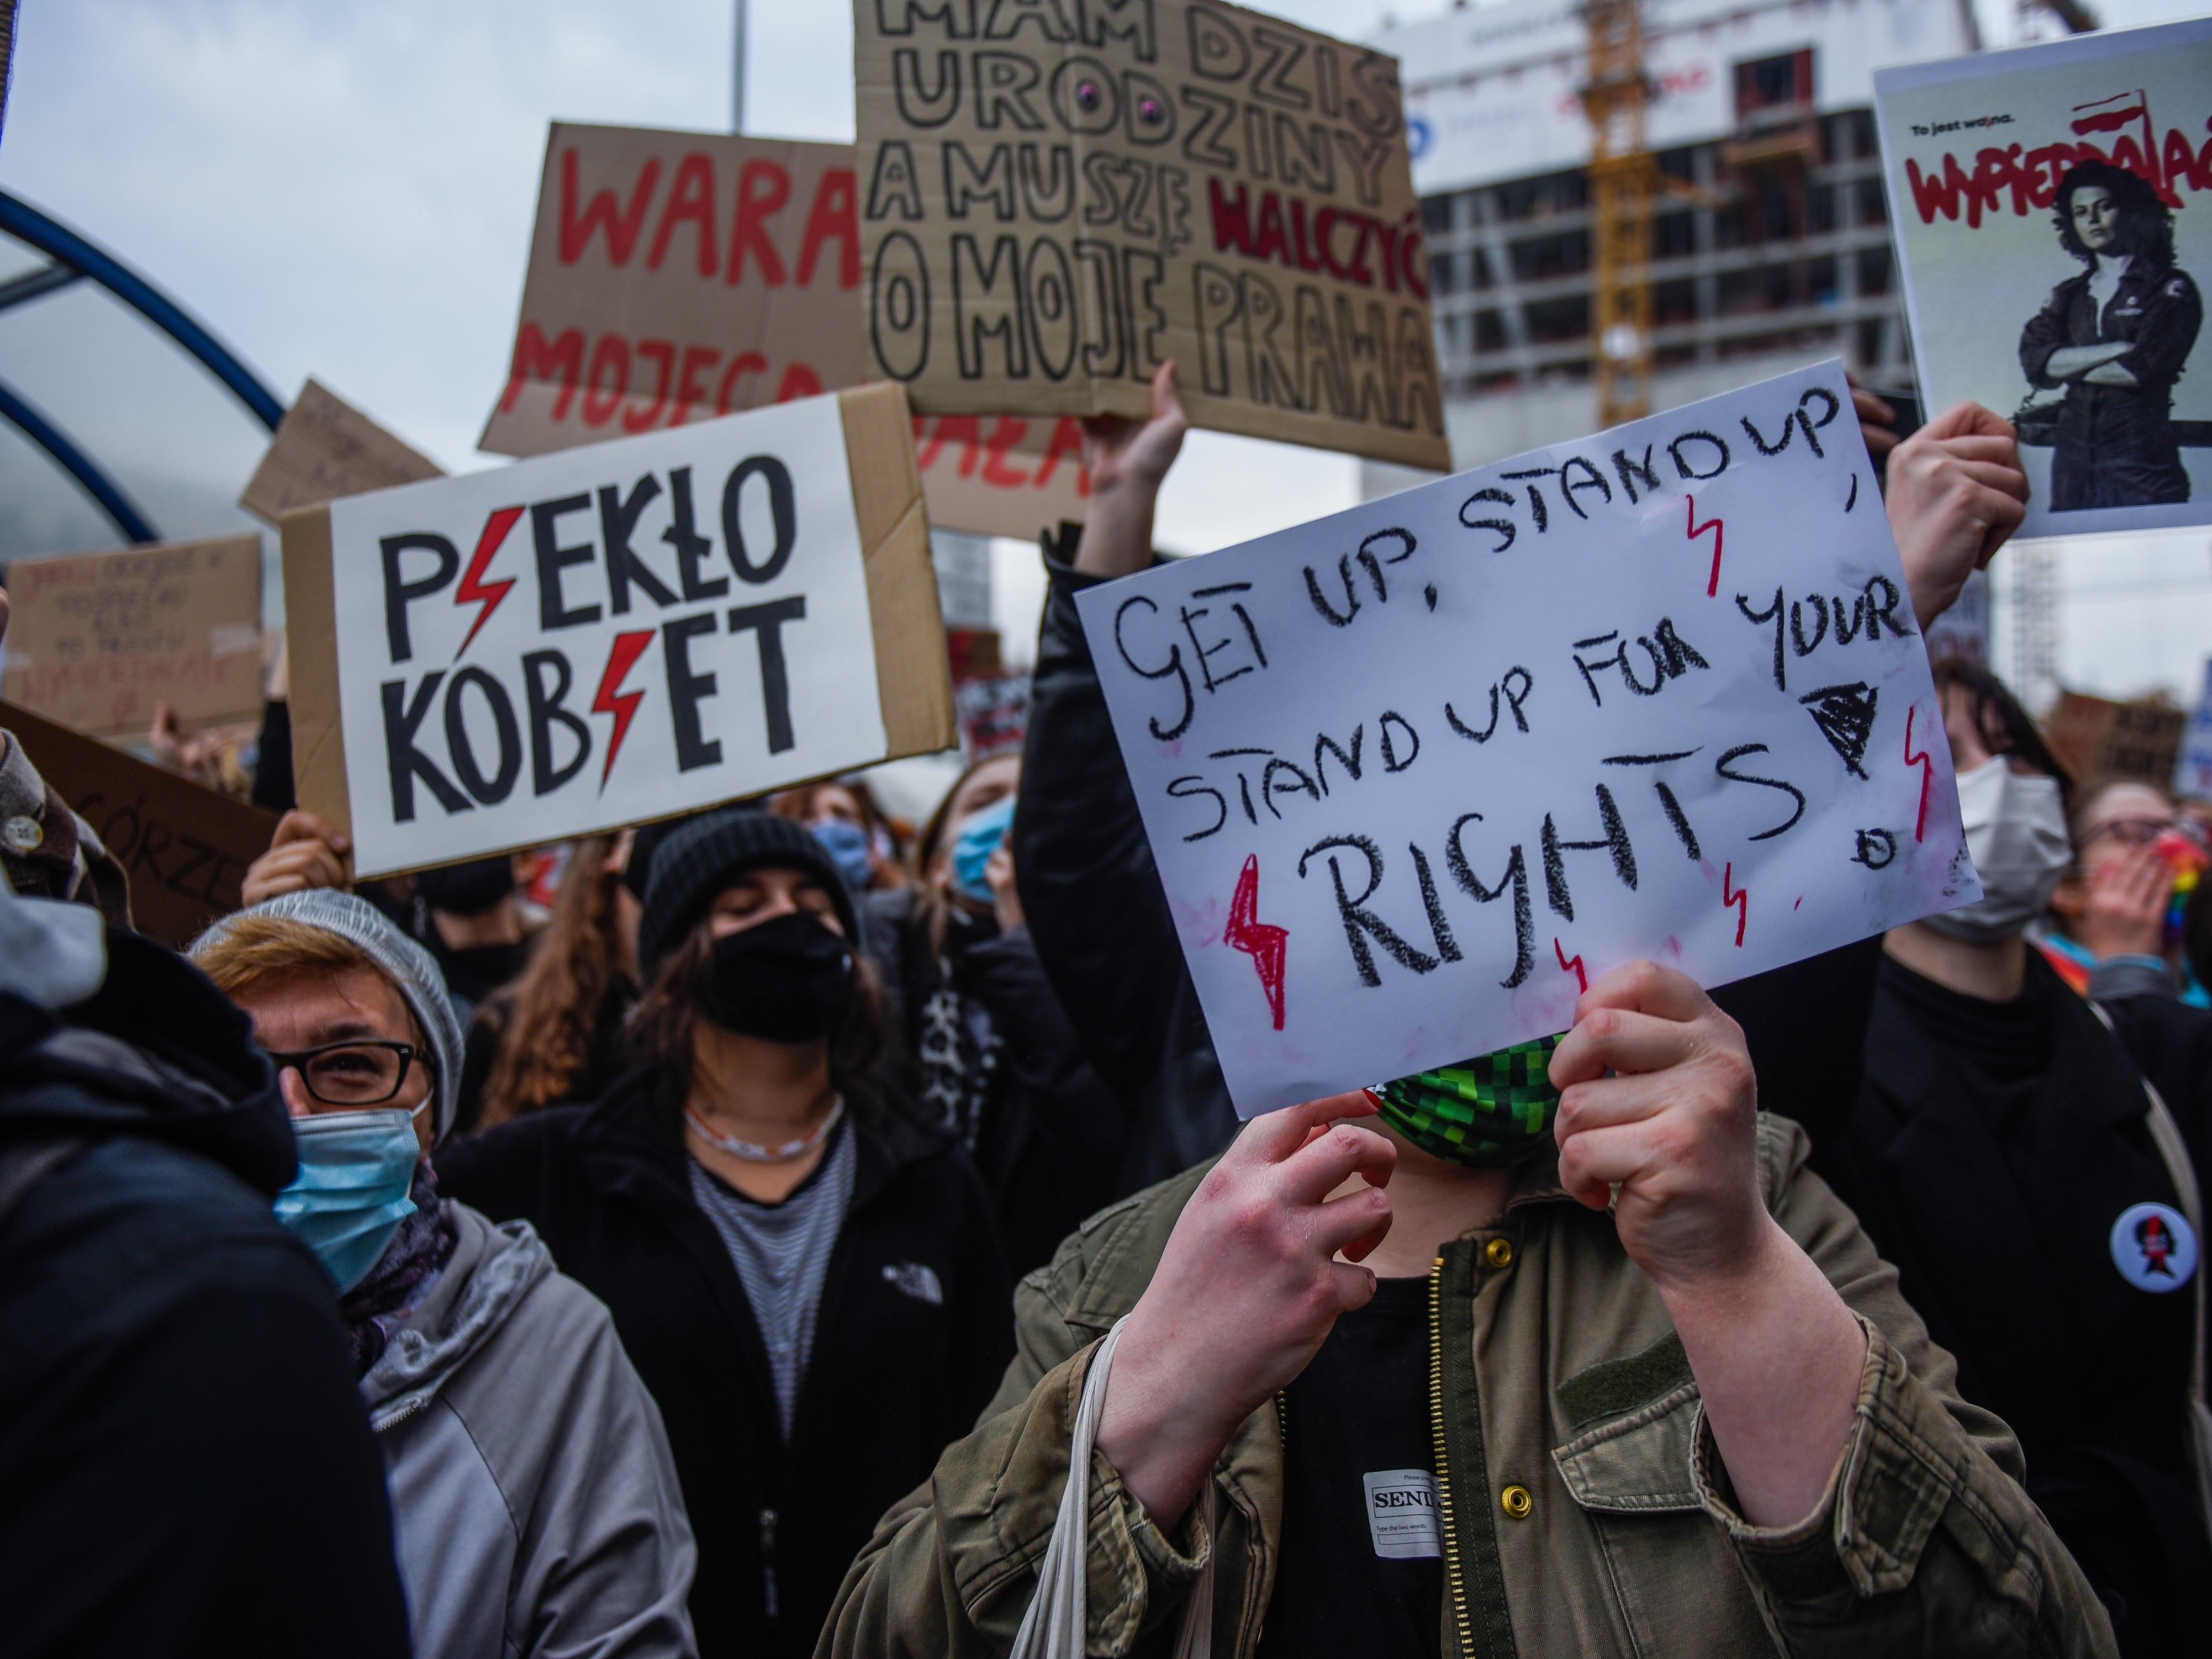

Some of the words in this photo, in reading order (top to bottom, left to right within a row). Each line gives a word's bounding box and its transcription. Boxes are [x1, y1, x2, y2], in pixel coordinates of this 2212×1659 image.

[875, 0, 1159, 63] MAM
[893, 47, 1392, 205] URODZINY
[1910, 125, 1929, 136] To
[1931, 120, 1961, 136] jest
[558, 147, 862, 291] WARA
[1208, 177, 1429, 302] WALCZYĆ
[1192, 260, 1444, 438] PRAWA
[1113, 580, 1271, 742] GET
[1165, 710, 1421, 843] STAND
[1443, 663, 1534, 746] UP
[1734, 574, 1915, 691] YOUR
